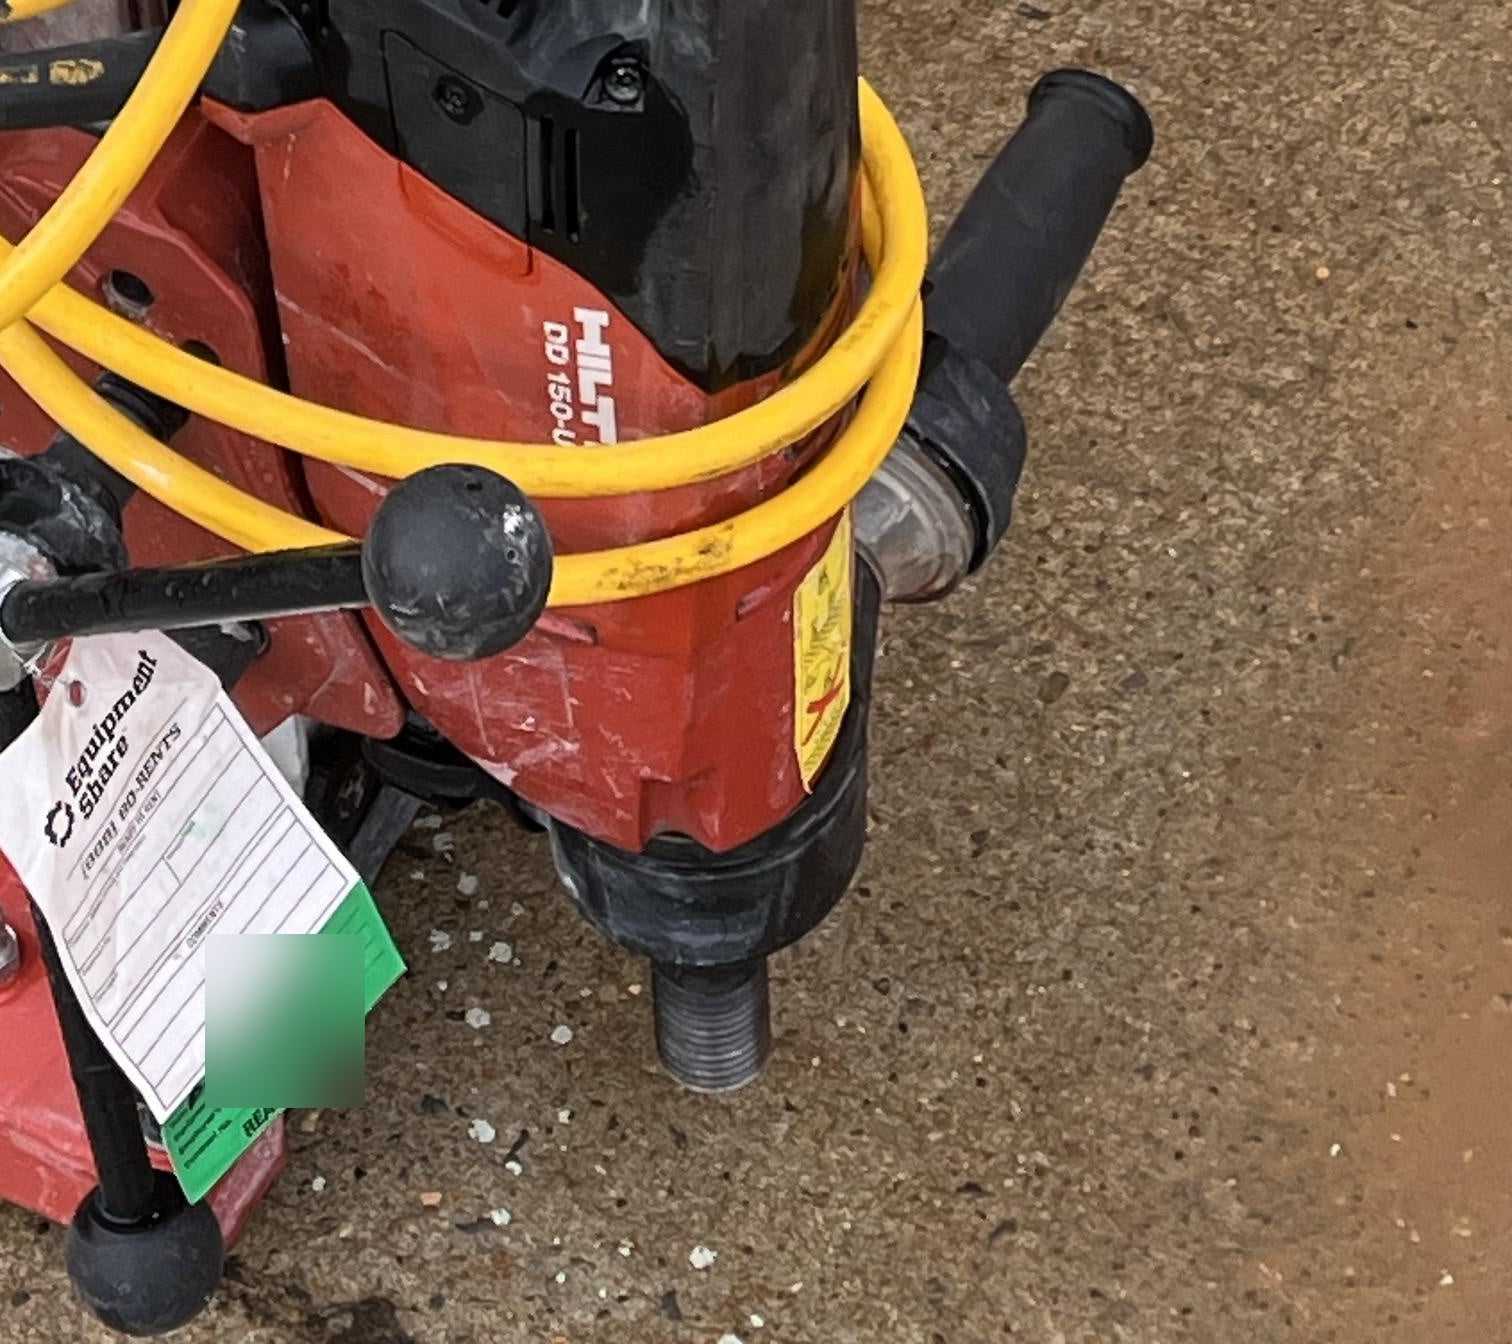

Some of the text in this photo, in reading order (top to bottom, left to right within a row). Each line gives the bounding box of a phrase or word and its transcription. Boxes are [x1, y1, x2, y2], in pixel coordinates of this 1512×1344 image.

[543, 320, 569, 365] DD
[573, 306, 617, 445] HILT
[65, 650, 157, 797] Equipment
[78, 734, 129, 820] Share
